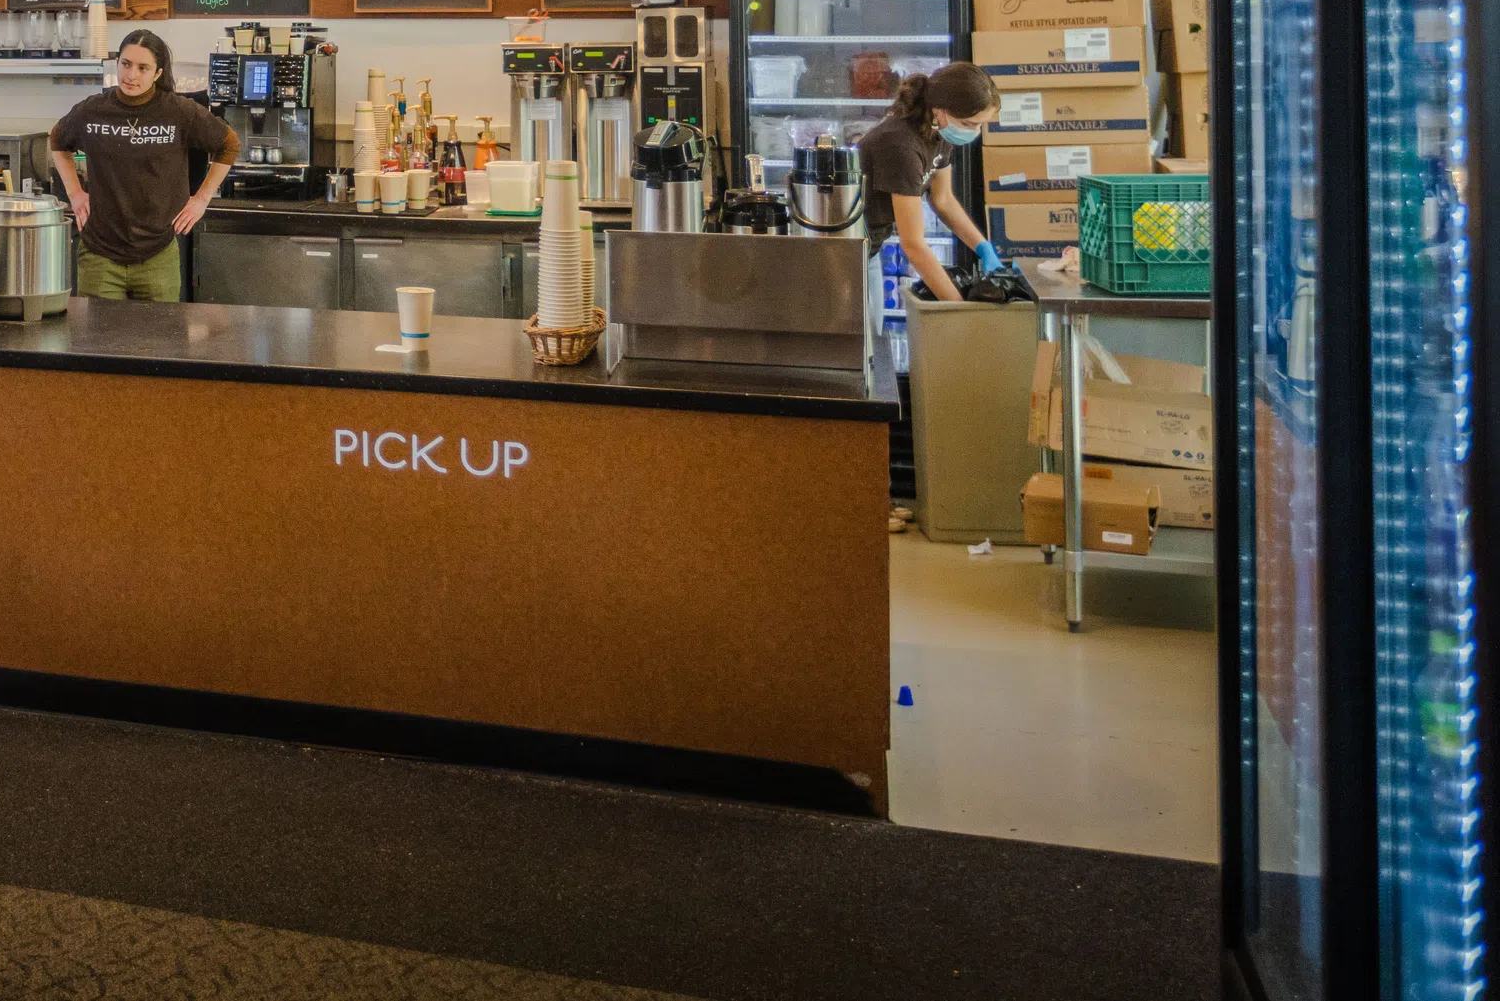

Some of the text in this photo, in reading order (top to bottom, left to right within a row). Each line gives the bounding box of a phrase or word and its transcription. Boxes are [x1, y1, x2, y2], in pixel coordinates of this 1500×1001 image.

[1009, 15, 1108, 28] KETTLE STYLE POTATO CHIPS
[1017, 62, 1100, 74] SUSTAINABLE
[1026, 120, 1108, 132] SUSTAINABLE
[130, 136, 169, 145] COFFEE
[1027, 179, 1078, 190] SUSTAIN
[1156, 410, 1191, 420] SL-PA-LG
[333, 428, 530, 480] PICK UP
